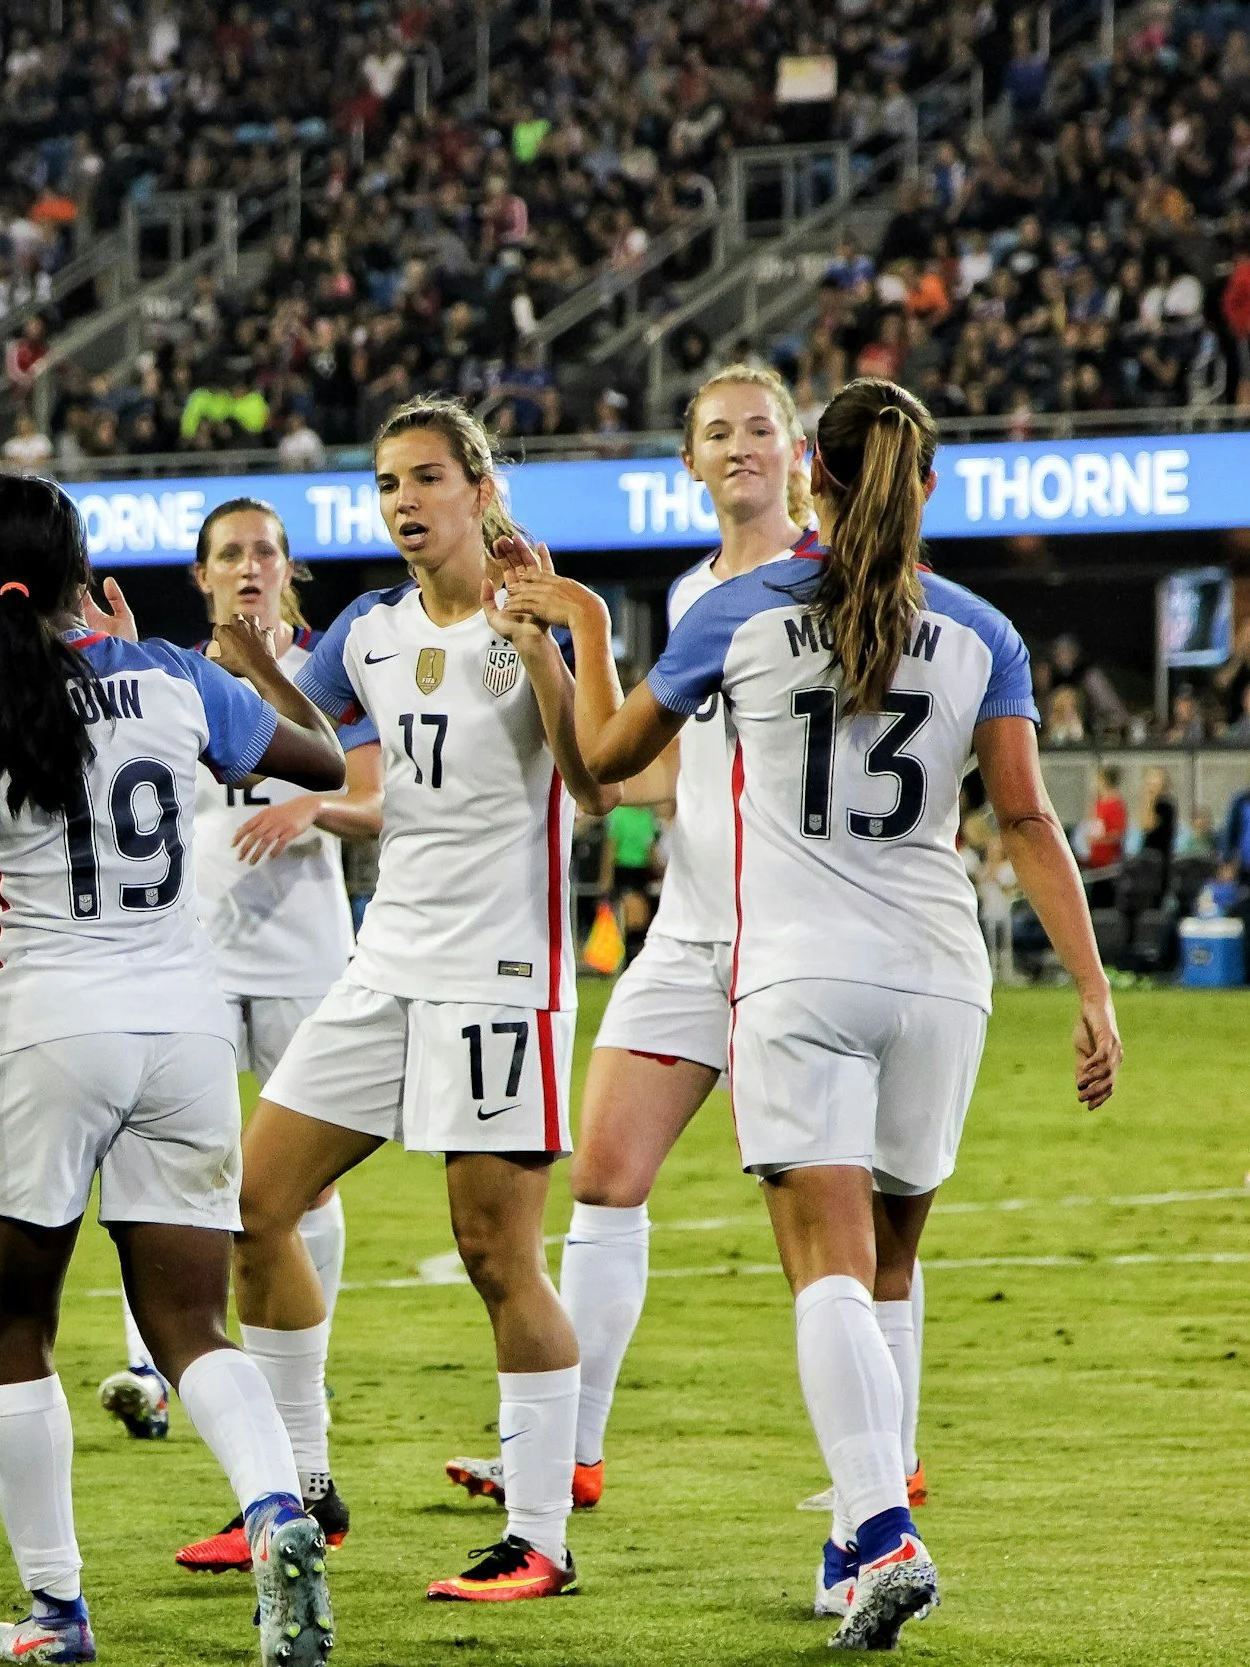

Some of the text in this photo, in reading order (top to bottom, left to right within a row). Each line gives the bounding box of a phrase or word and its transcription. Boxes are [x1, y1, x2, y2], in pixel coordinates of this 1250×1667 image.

[618, 471, 719, 534] THO
[955, 450, 1190, 521] THORNE
[79, 491, 206, 553] ORNE
[489, 651, 516, 669] USA
[69, 679, 144, 725] UNN
[398, 713, 448, 788] 17
[790, 686, 933, 842] 13
[61, 756, 186, 920] 19
[461, 1021, 529, 1099] 17
